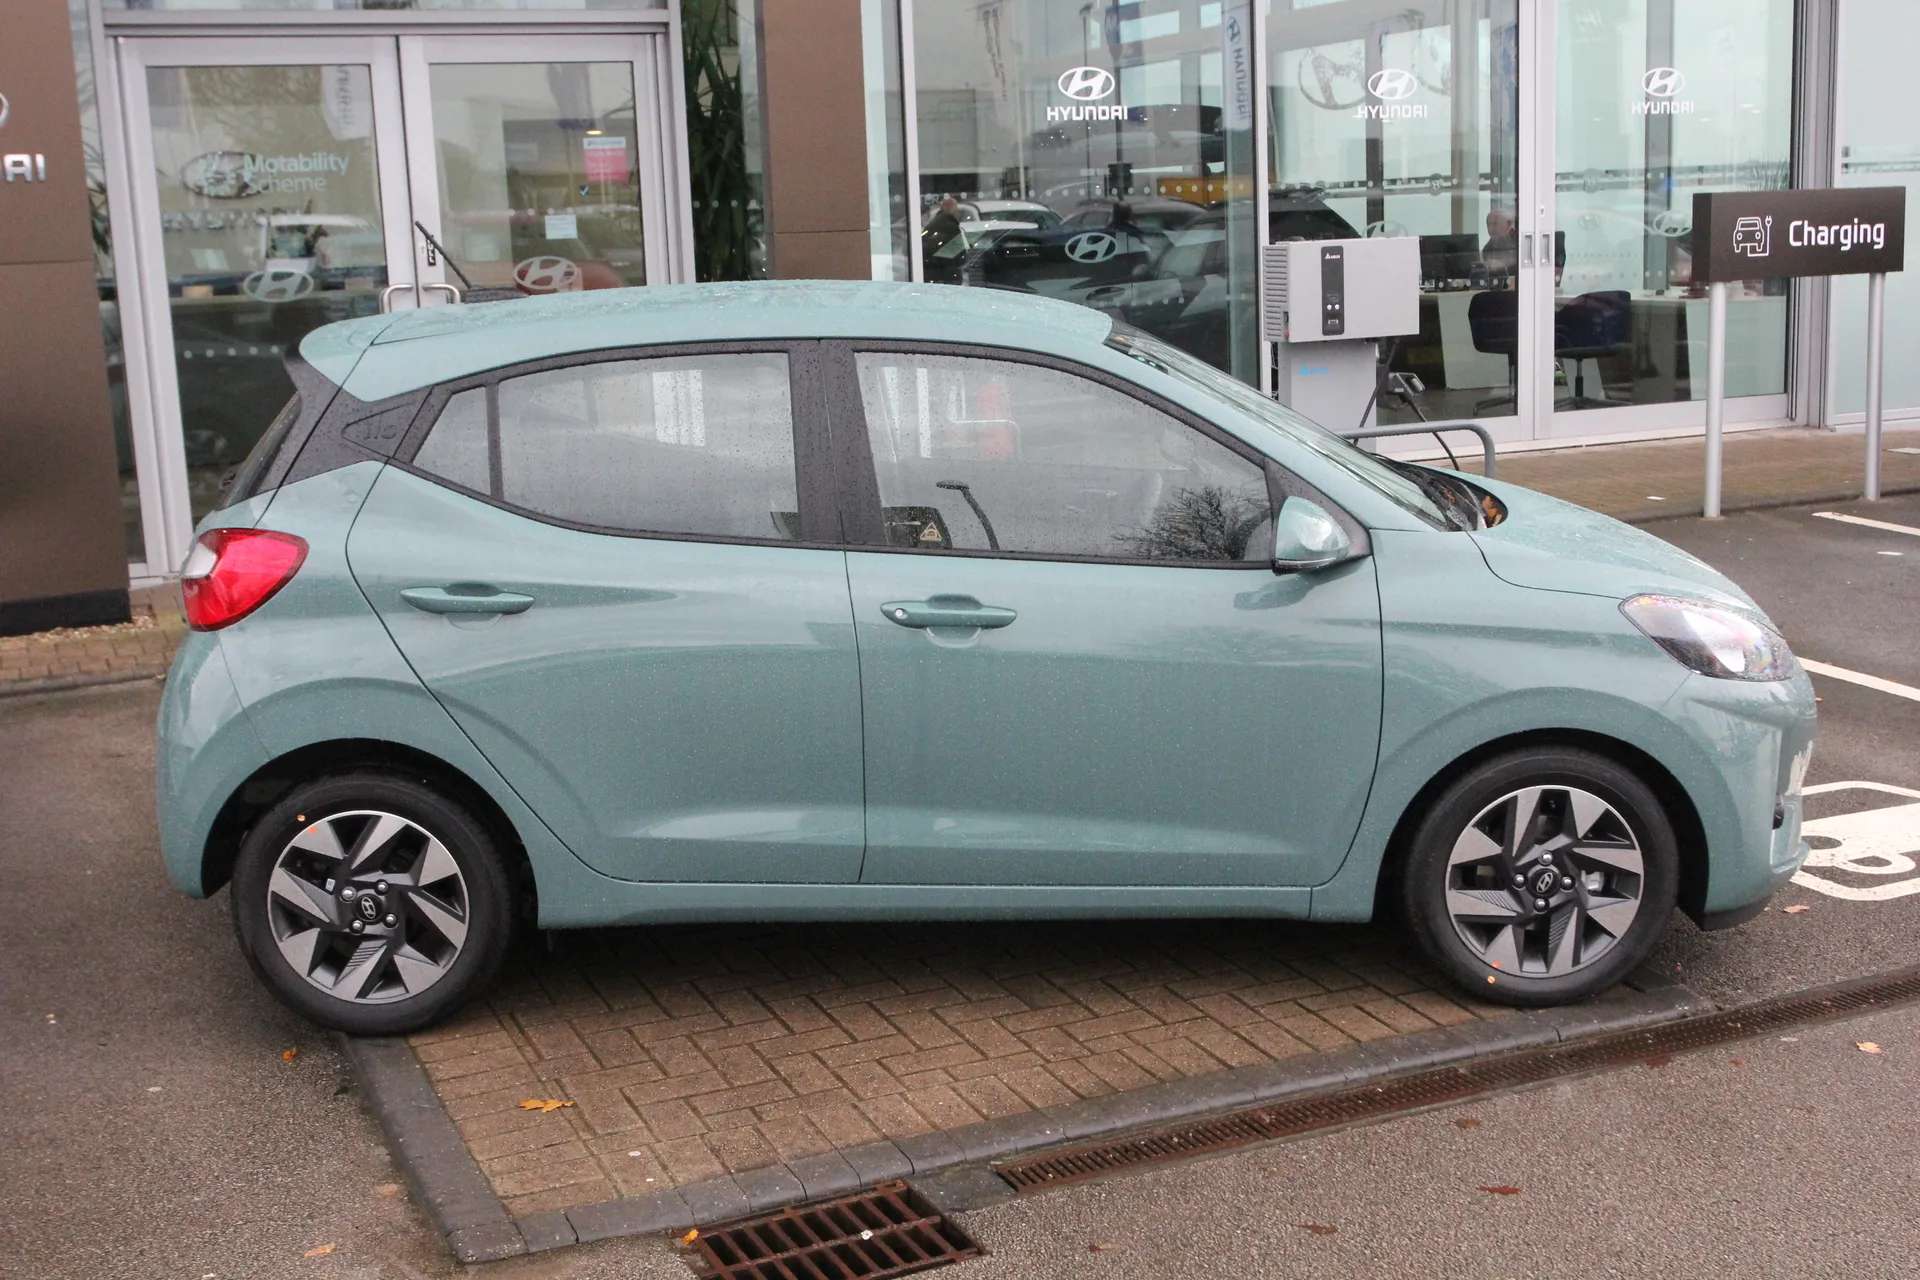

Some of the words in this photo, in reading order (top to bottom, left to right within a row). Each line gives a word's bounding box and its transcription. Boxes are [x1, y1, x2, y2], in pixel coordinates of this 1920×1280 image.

[1047, 105, 1128, 121] HYUNDAI
[1358, 104, 1428, 120] HYUNDAI
[1631, 100, 1695, 115] HYUNDAI
[243, 152, 351, 177] Motability
[1789, 218, 1884, 251] Charging
